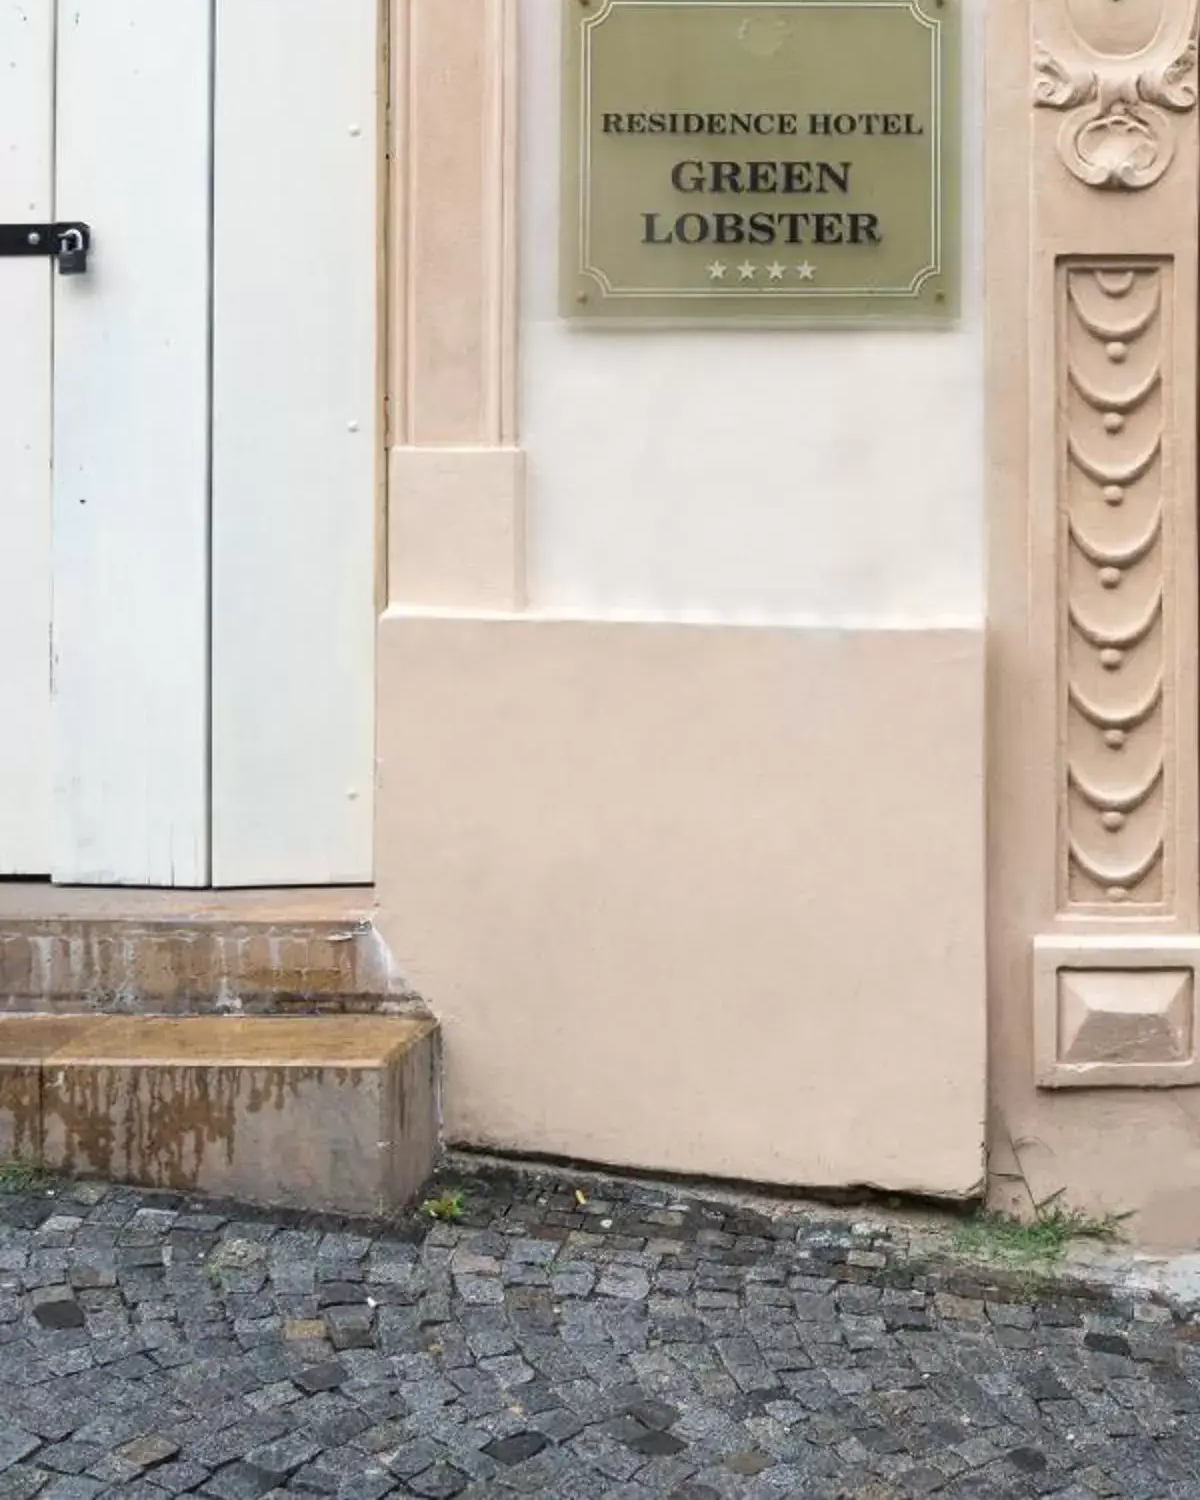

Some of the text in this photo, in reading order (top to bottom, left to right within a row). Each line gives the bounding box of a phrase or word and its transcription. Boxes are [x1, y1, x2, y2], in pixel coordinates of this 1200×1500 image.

[601, 112, 924, 136] RESIDENCE HOTEL
[671, 160, 852, 194] GREEN
[640, 212, 883, 246] LOBSTER
